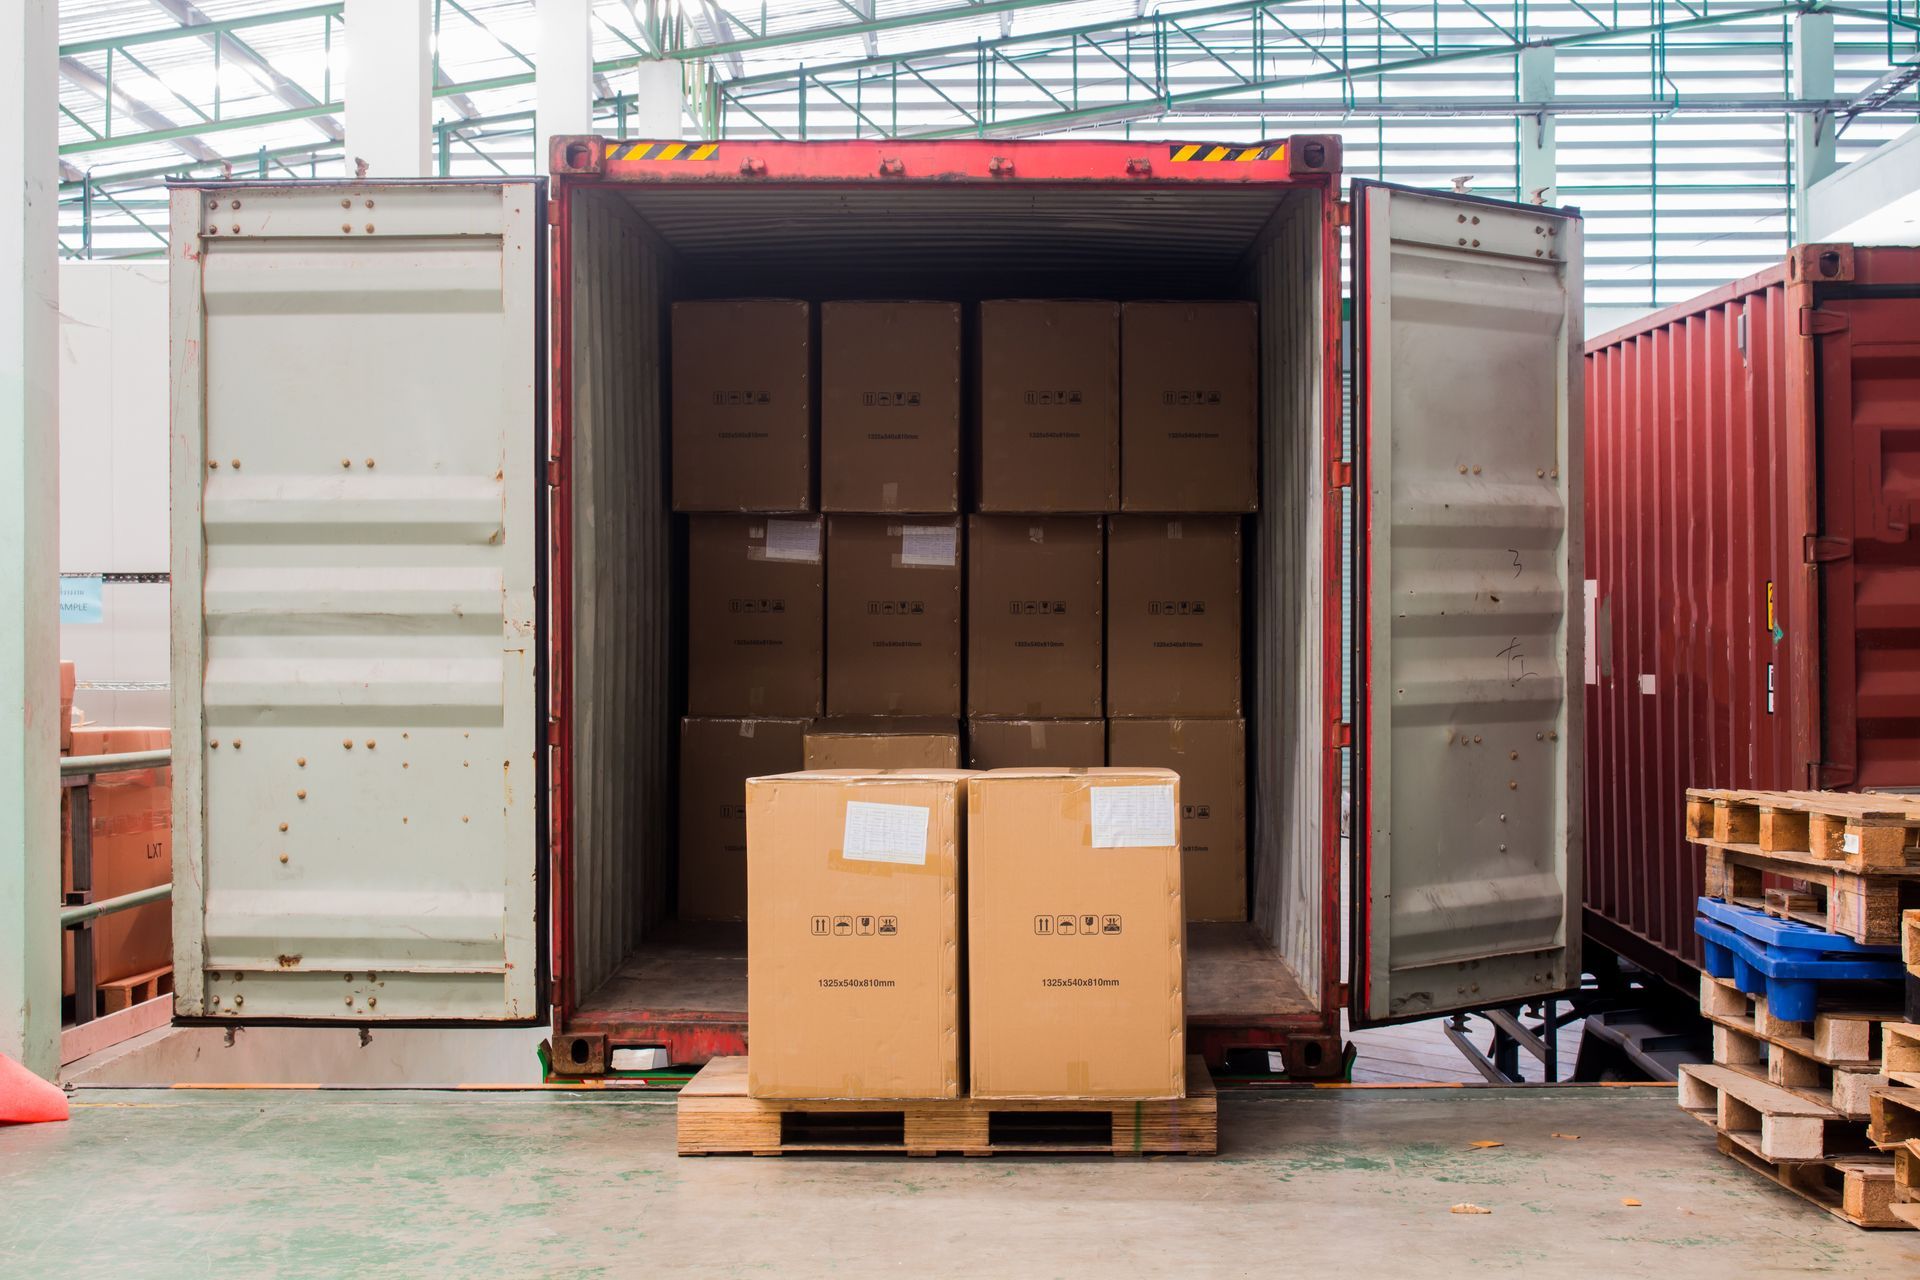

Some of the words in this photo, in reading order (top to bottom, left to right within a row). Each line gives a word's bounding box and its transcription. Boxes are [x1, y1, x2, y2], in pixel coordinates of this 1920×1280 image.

[147, 843, 162, 859] LXT
[818, 979, 895, 987] 1325x540x810mm
[1042, 978, 1120, 987] 1325x540x810mm
